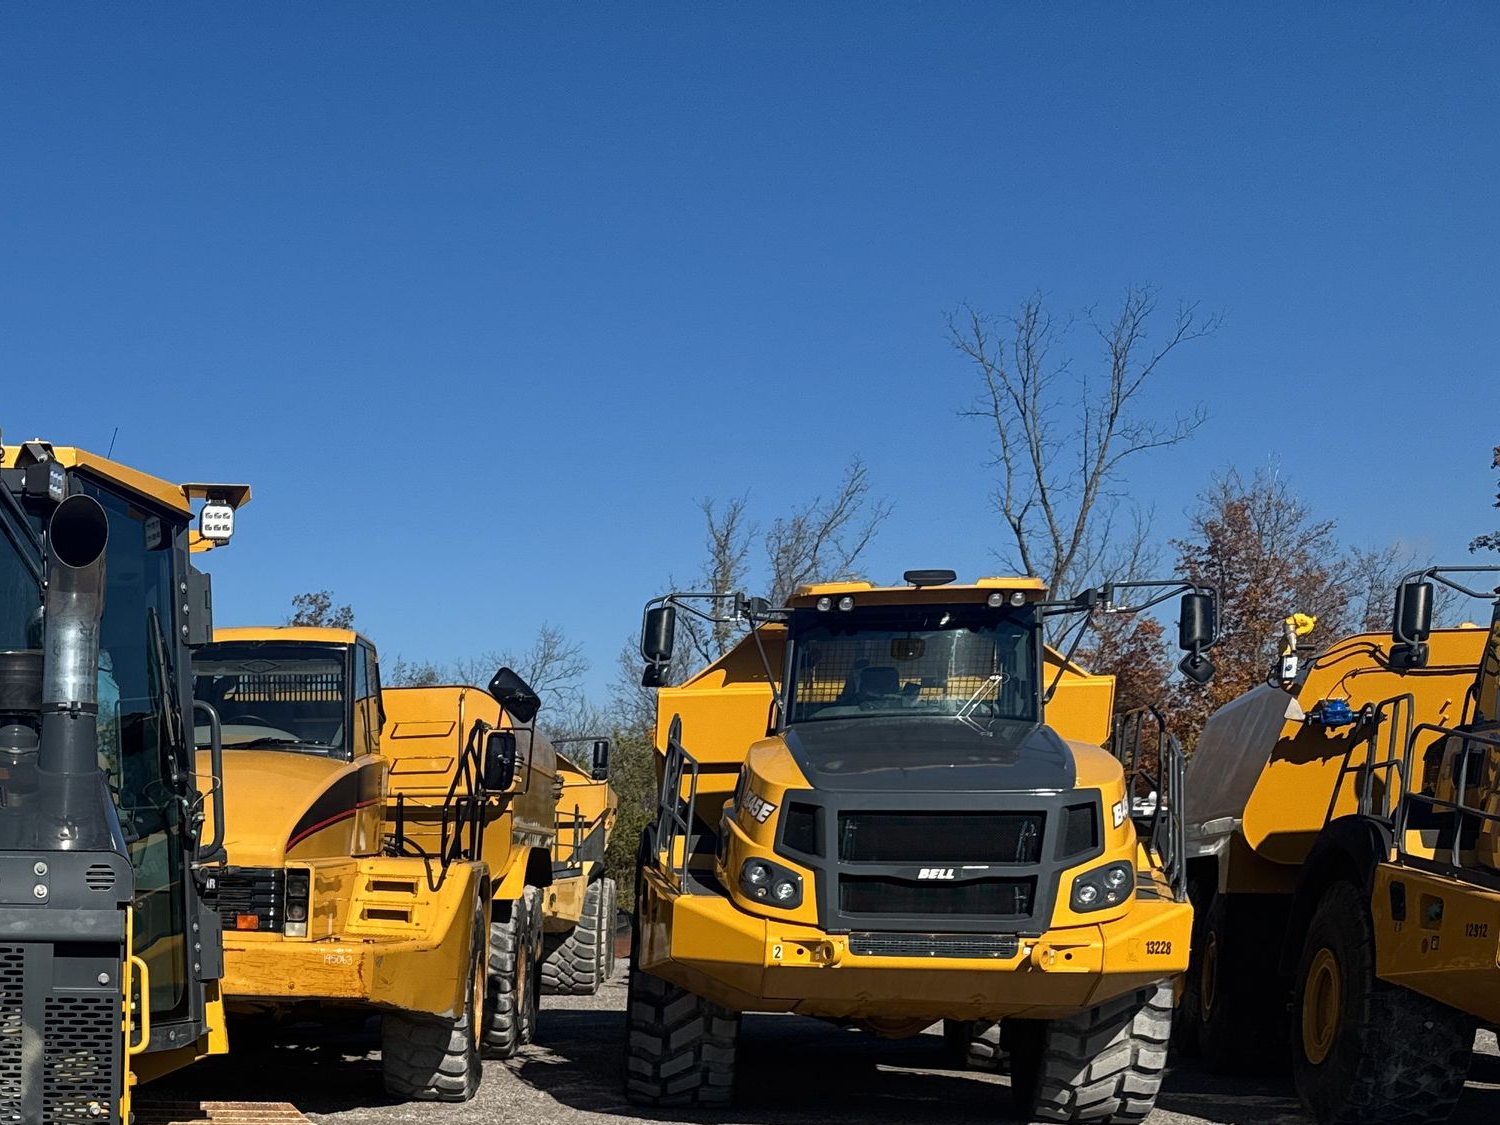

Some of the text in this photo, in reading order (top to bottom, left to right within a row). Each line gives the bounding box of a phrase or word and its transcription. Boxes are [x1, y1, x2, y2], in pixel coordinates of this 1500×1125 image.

[918, 868, 955, 880] BELL
[1465, 922, 1488, 938] 12912
[774, 945, 781, 959] 2
[1145, 940, 1172, 955] 13228
